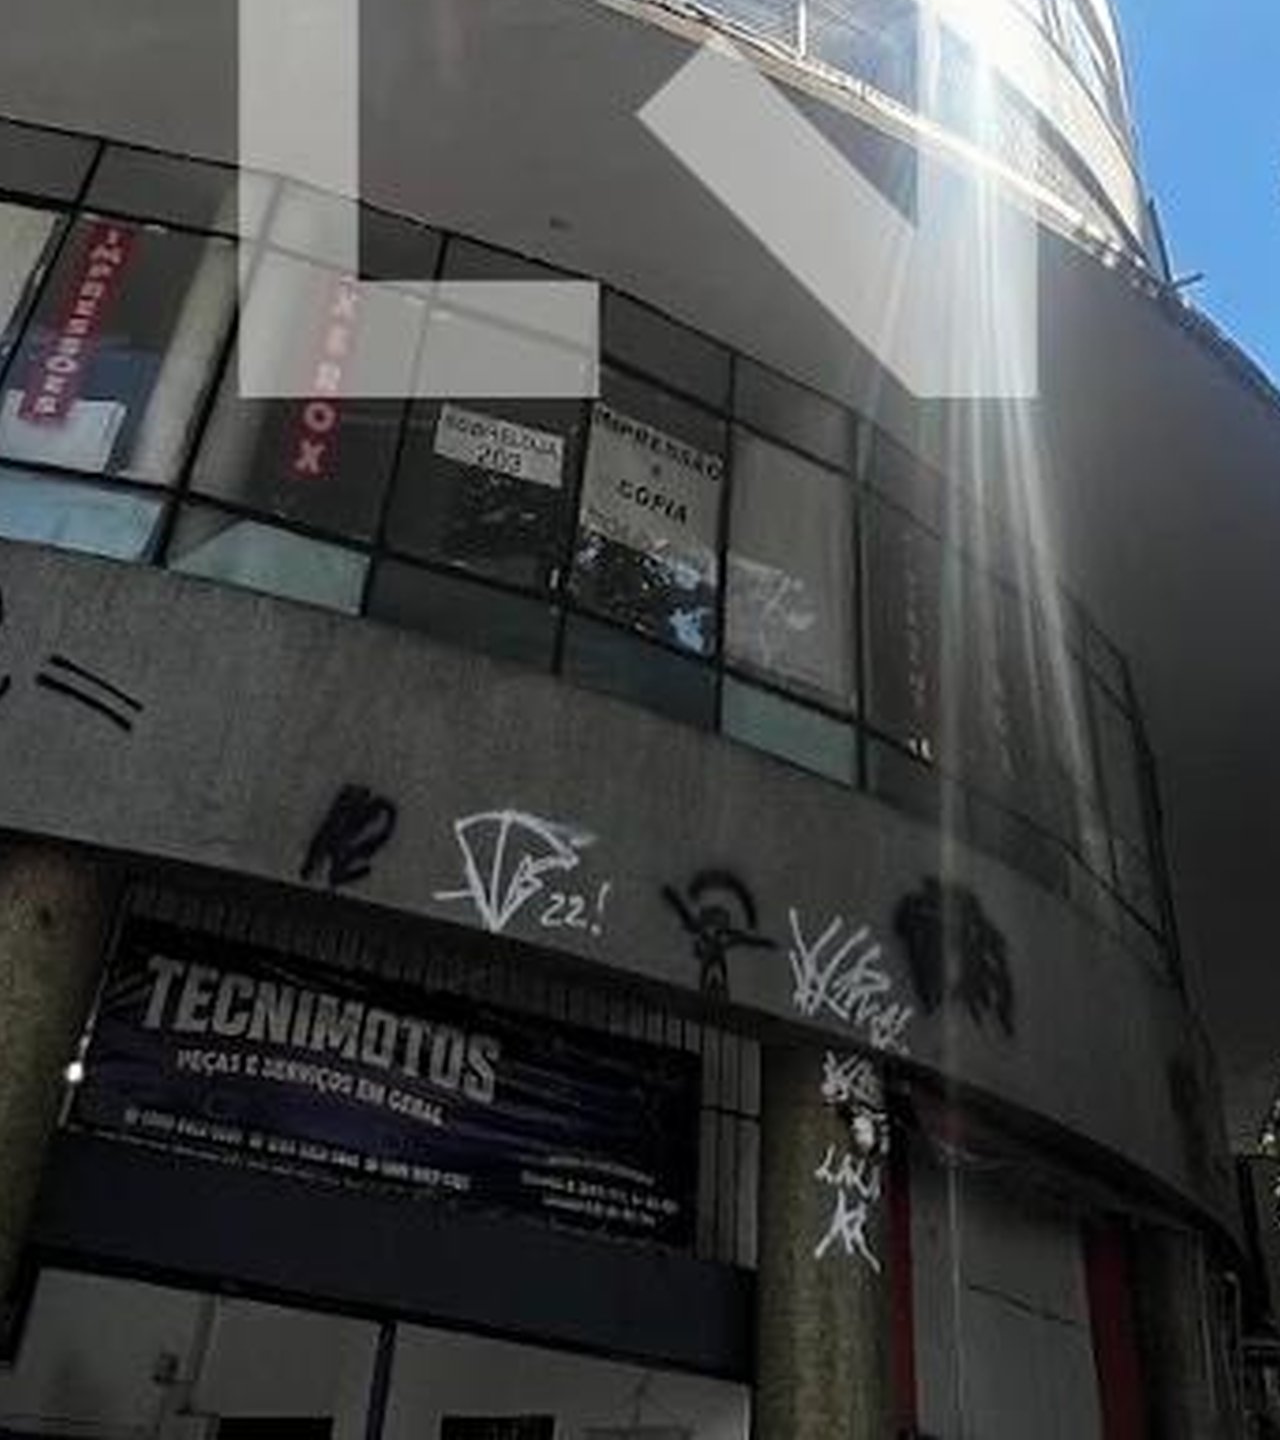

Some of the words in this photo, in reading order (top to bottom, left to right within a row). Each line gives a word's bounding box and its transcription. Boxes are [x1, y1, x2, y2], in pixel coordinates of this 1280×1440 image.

[294, 278, 361, 475] XEROX
[143, 955, 502, 1105] TECNIMOTOS
[176, 1048, 241, 1077] PEÇAS
